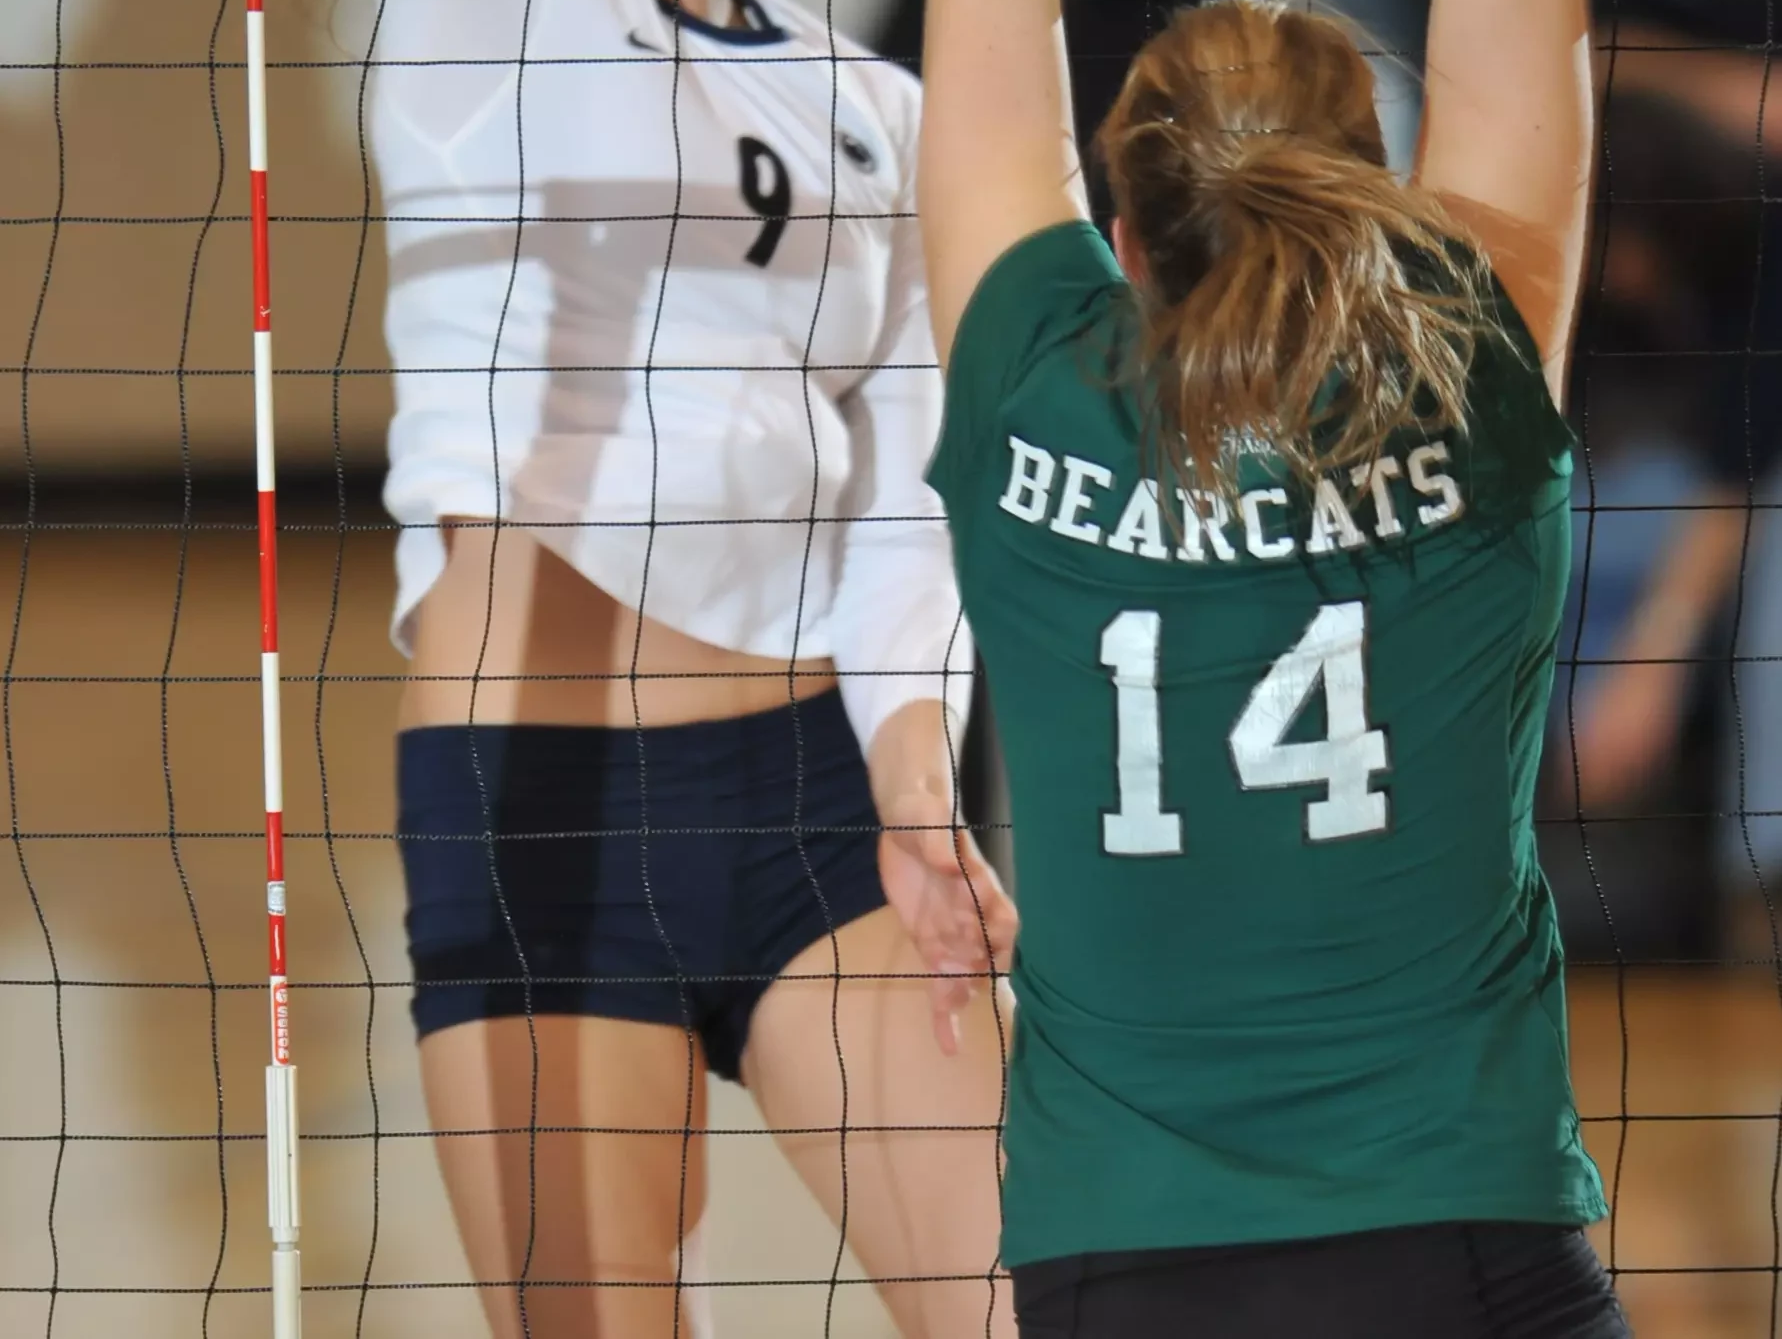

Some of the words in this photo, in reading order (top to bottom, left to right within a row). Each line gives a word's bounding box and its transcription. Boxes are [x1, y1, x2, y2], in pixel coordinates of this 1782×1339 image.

[737, 135, 792, 268] 9
[999, 434, 1466, 563] BEARCATS
[1100, 600, 1389, 855] 14
